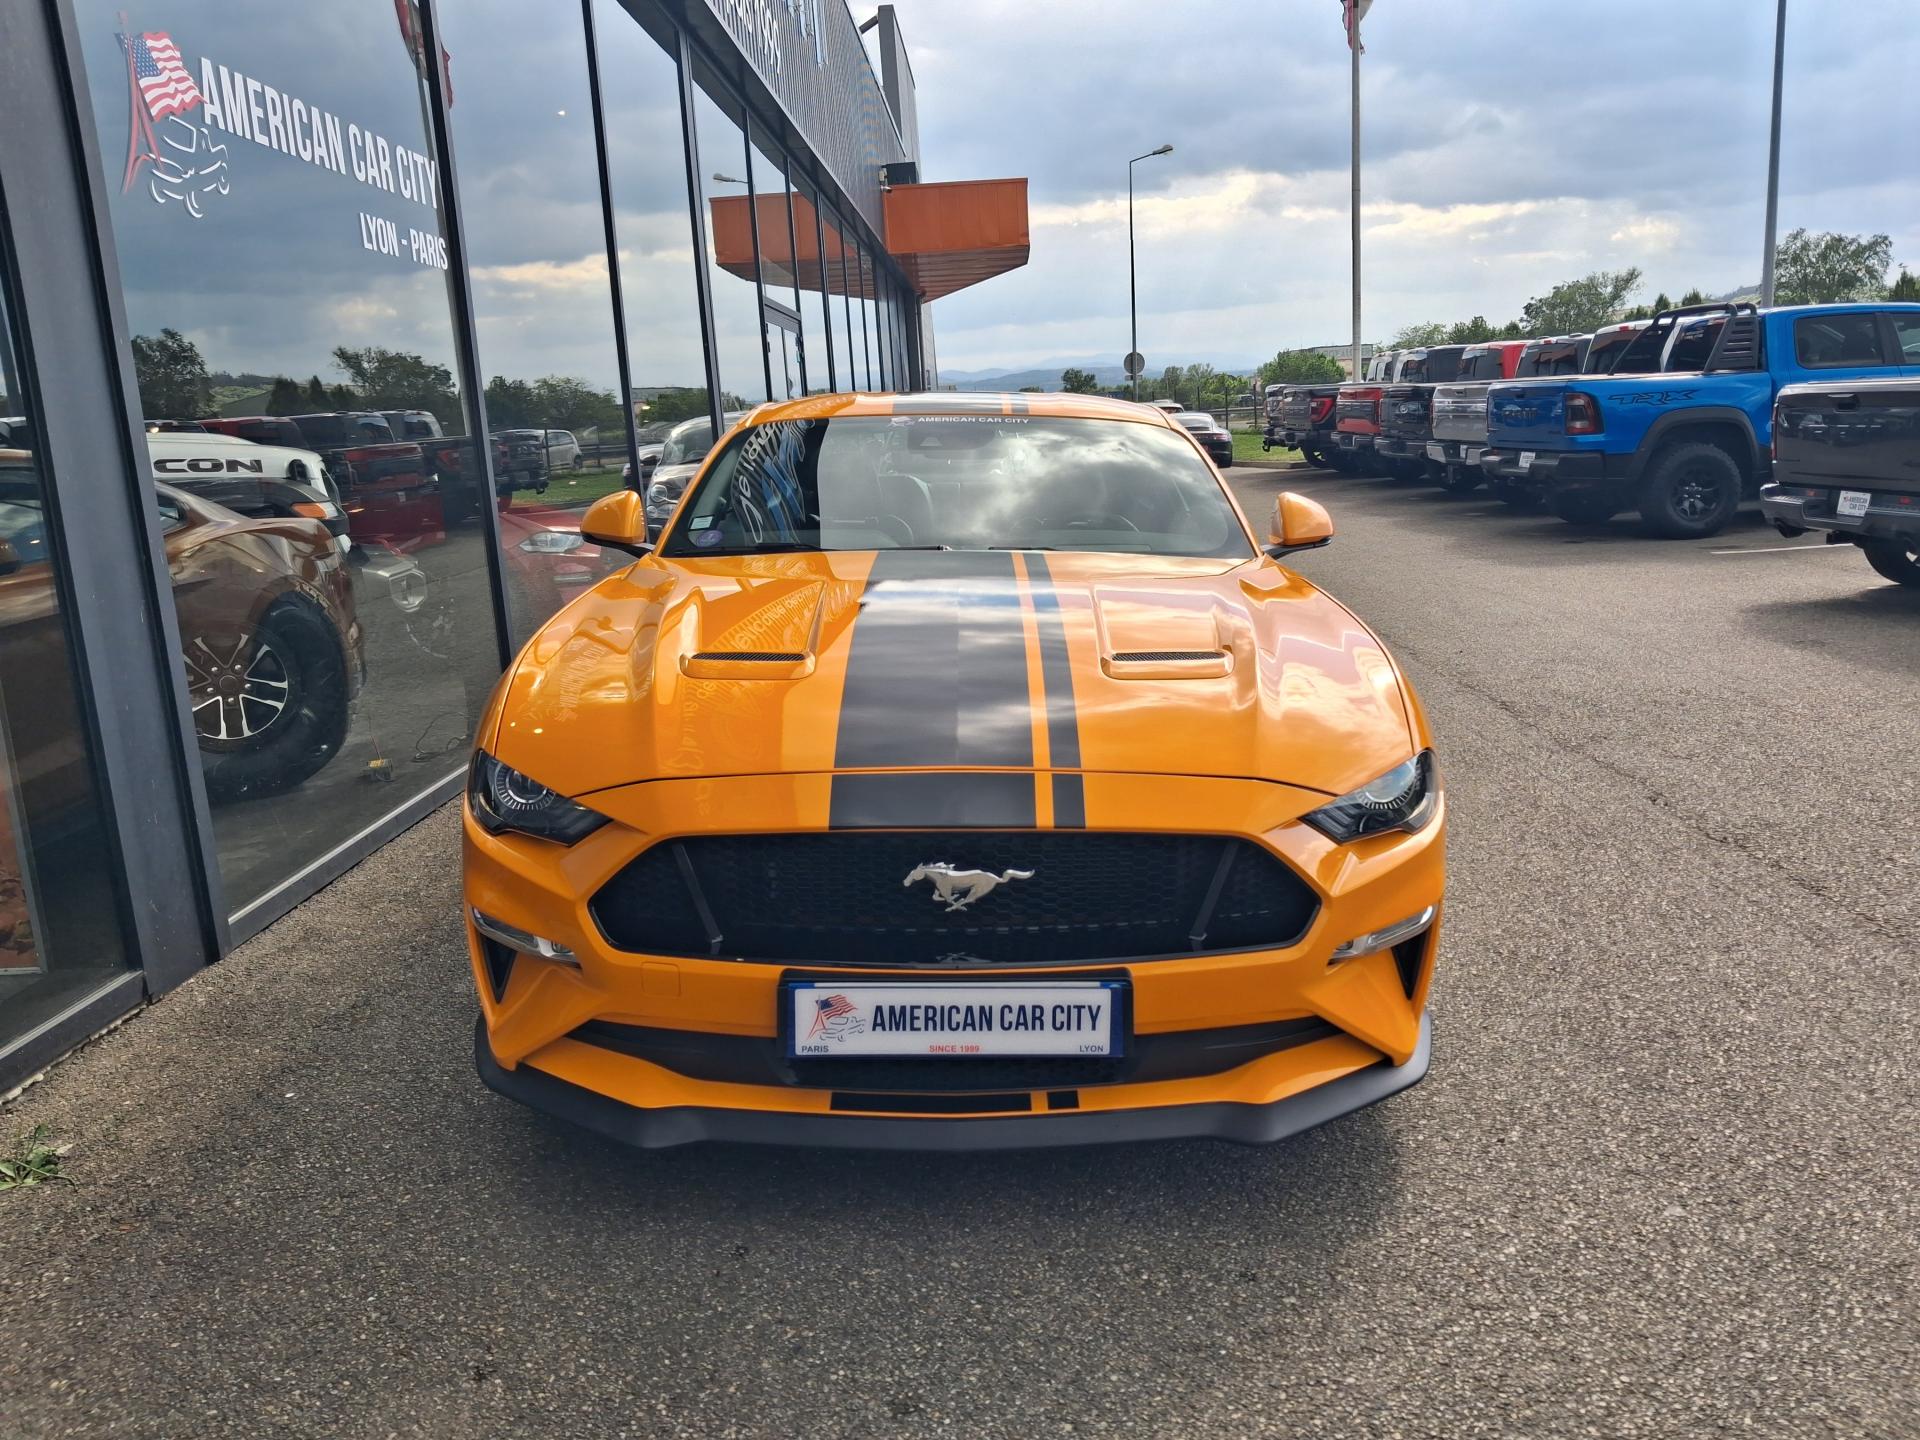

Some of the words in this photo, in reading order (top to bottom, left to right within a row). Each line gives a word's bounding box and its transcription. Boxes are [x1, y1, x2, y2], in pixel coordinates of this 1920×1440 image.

[200, 57, 346, 174] AMERICAN
[348, 123, 394, 193] CAR
[396, 145, 438, 209] CITY
[359, 212, 399, 257] LYON
[409, 228, 449, 270] PARIS
[1607, 388, 1703, 406] TRX
[871, 1004, 993, 1032] AMERICAN
[1000, 1004, 1045, 1031] CAR
[1051, 1004, 1102, 1031] CITY
[801, 1045, 829, 1053] PARIS
[929, 1045, 957, 1053] SINCE
[960, 1045, 980, 1053] 1999
[1079, 1045, 1104, 1053] LYON
